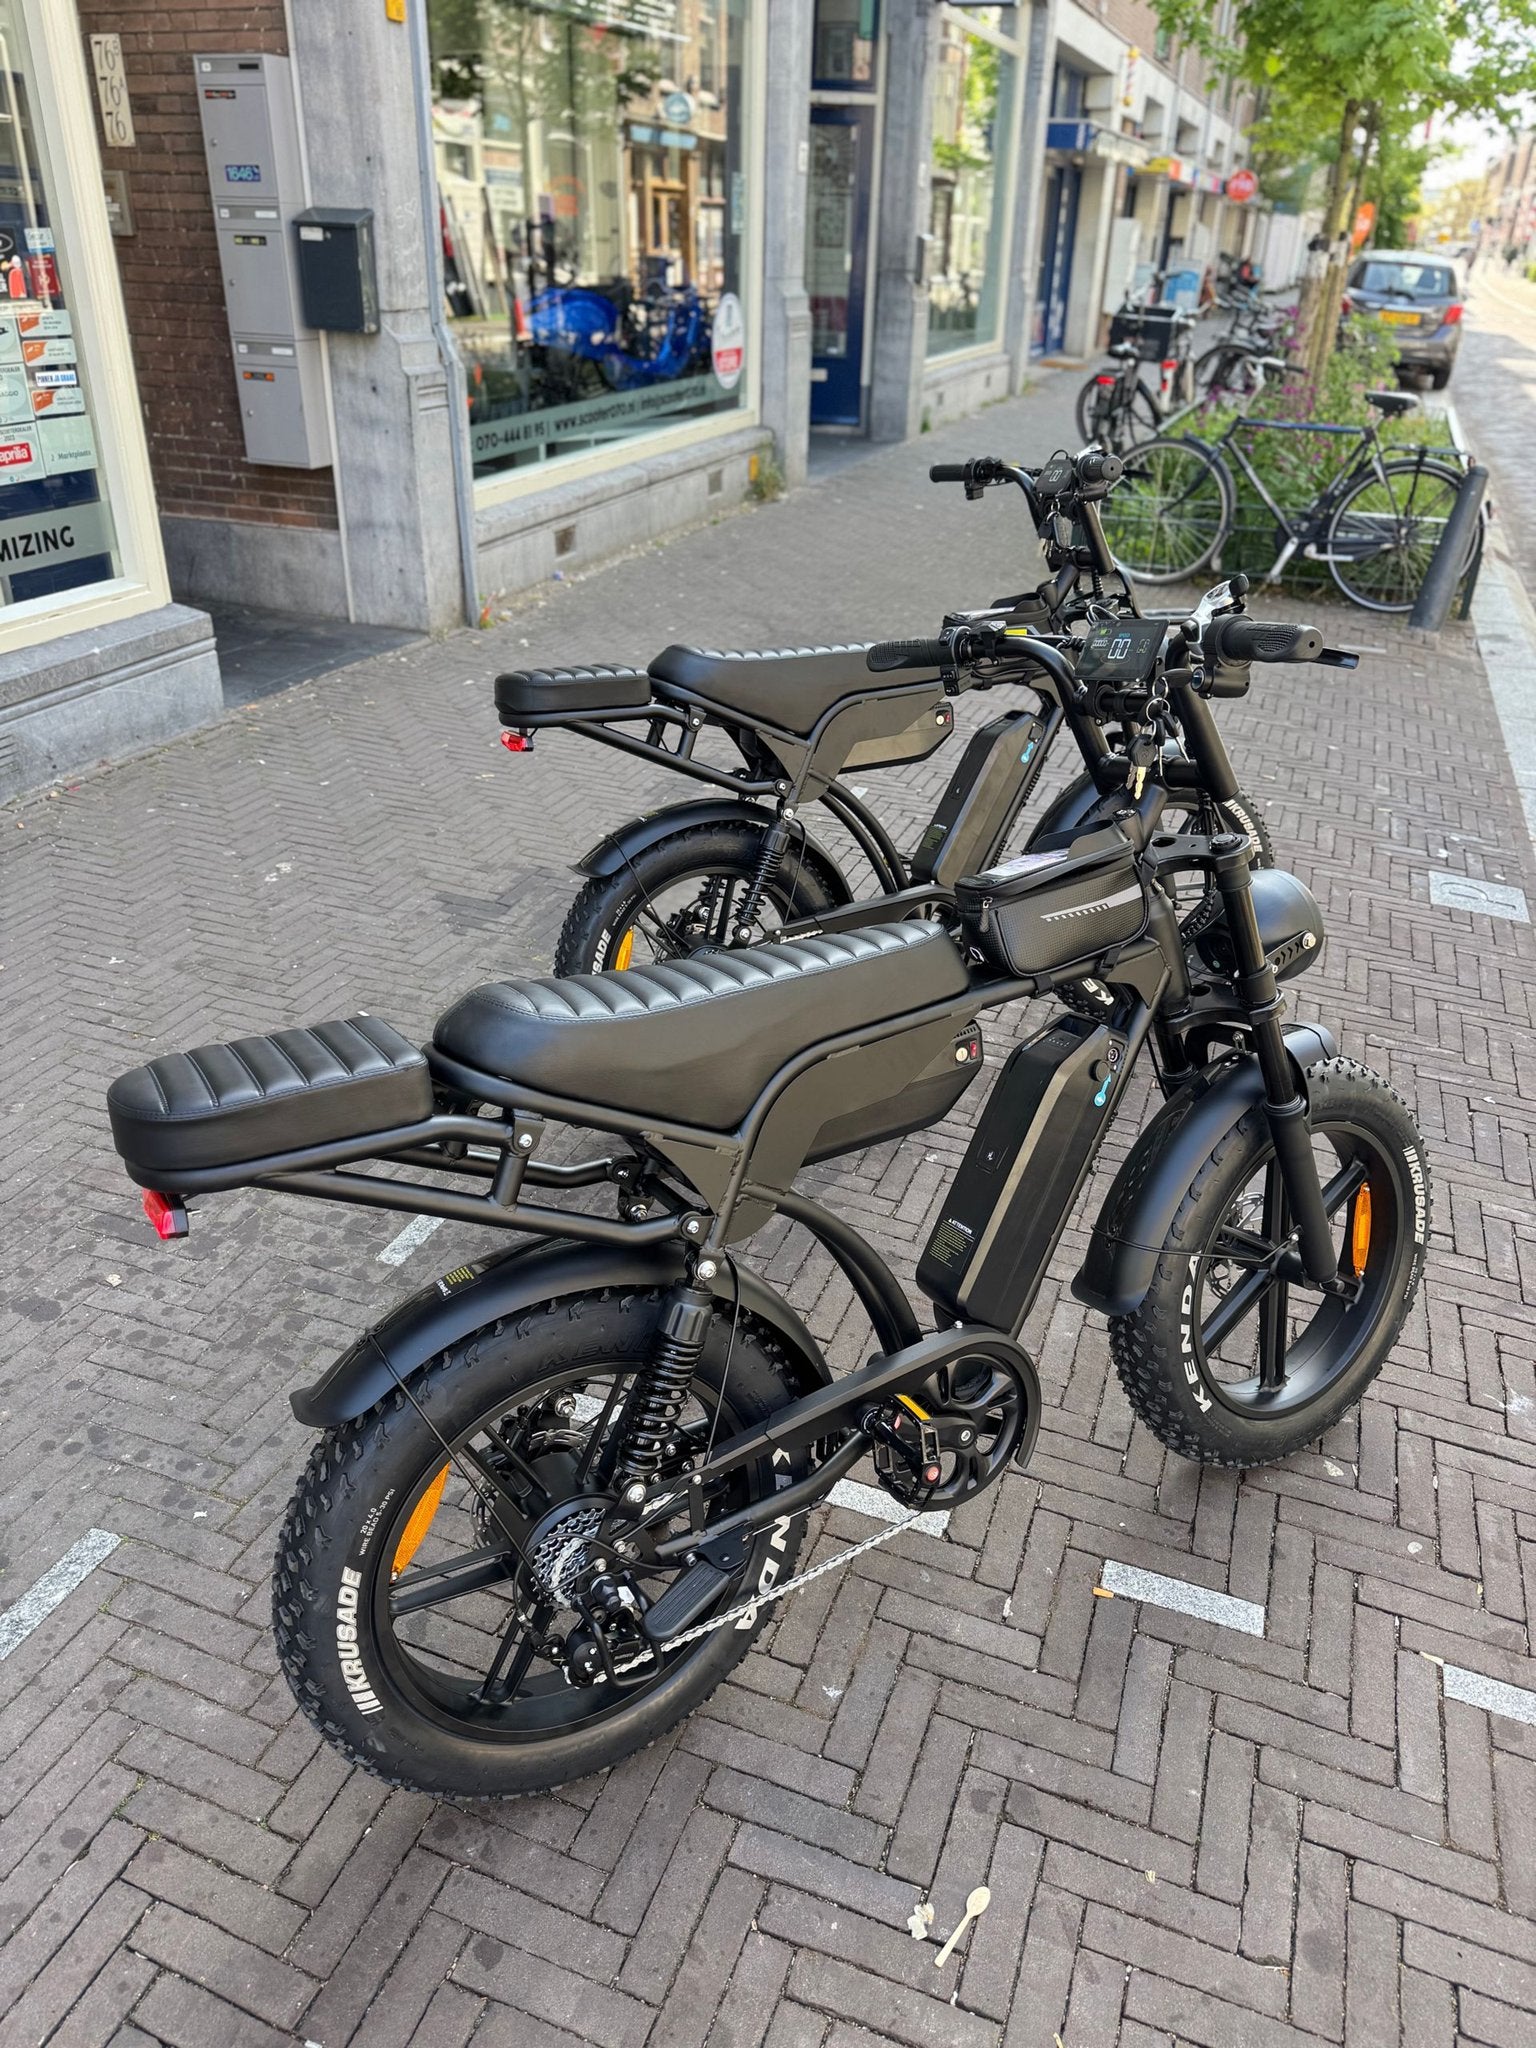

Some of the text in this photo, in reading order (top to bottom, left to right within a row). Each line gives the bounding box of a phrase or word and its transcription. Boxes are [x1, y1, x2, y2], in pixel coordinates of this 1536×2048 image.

[106, 111, 126, 141] 76
[1107, 638, 1132, 659] 00
[1408, 1161, 1426, 1245] KRUSADE
[1180, 1250, 1213, 1413] KENDA
[359, 1537, 371, 1556] WIRE
[366, 1517, 379, 1536] BEAD
[385, 1488, 396, 1500] PSI
[360, 1525, 369, 1534] 20
[367, 1507, 377, 1519] 4.0
[336, 1566, 372, 1693] KRUSADE
